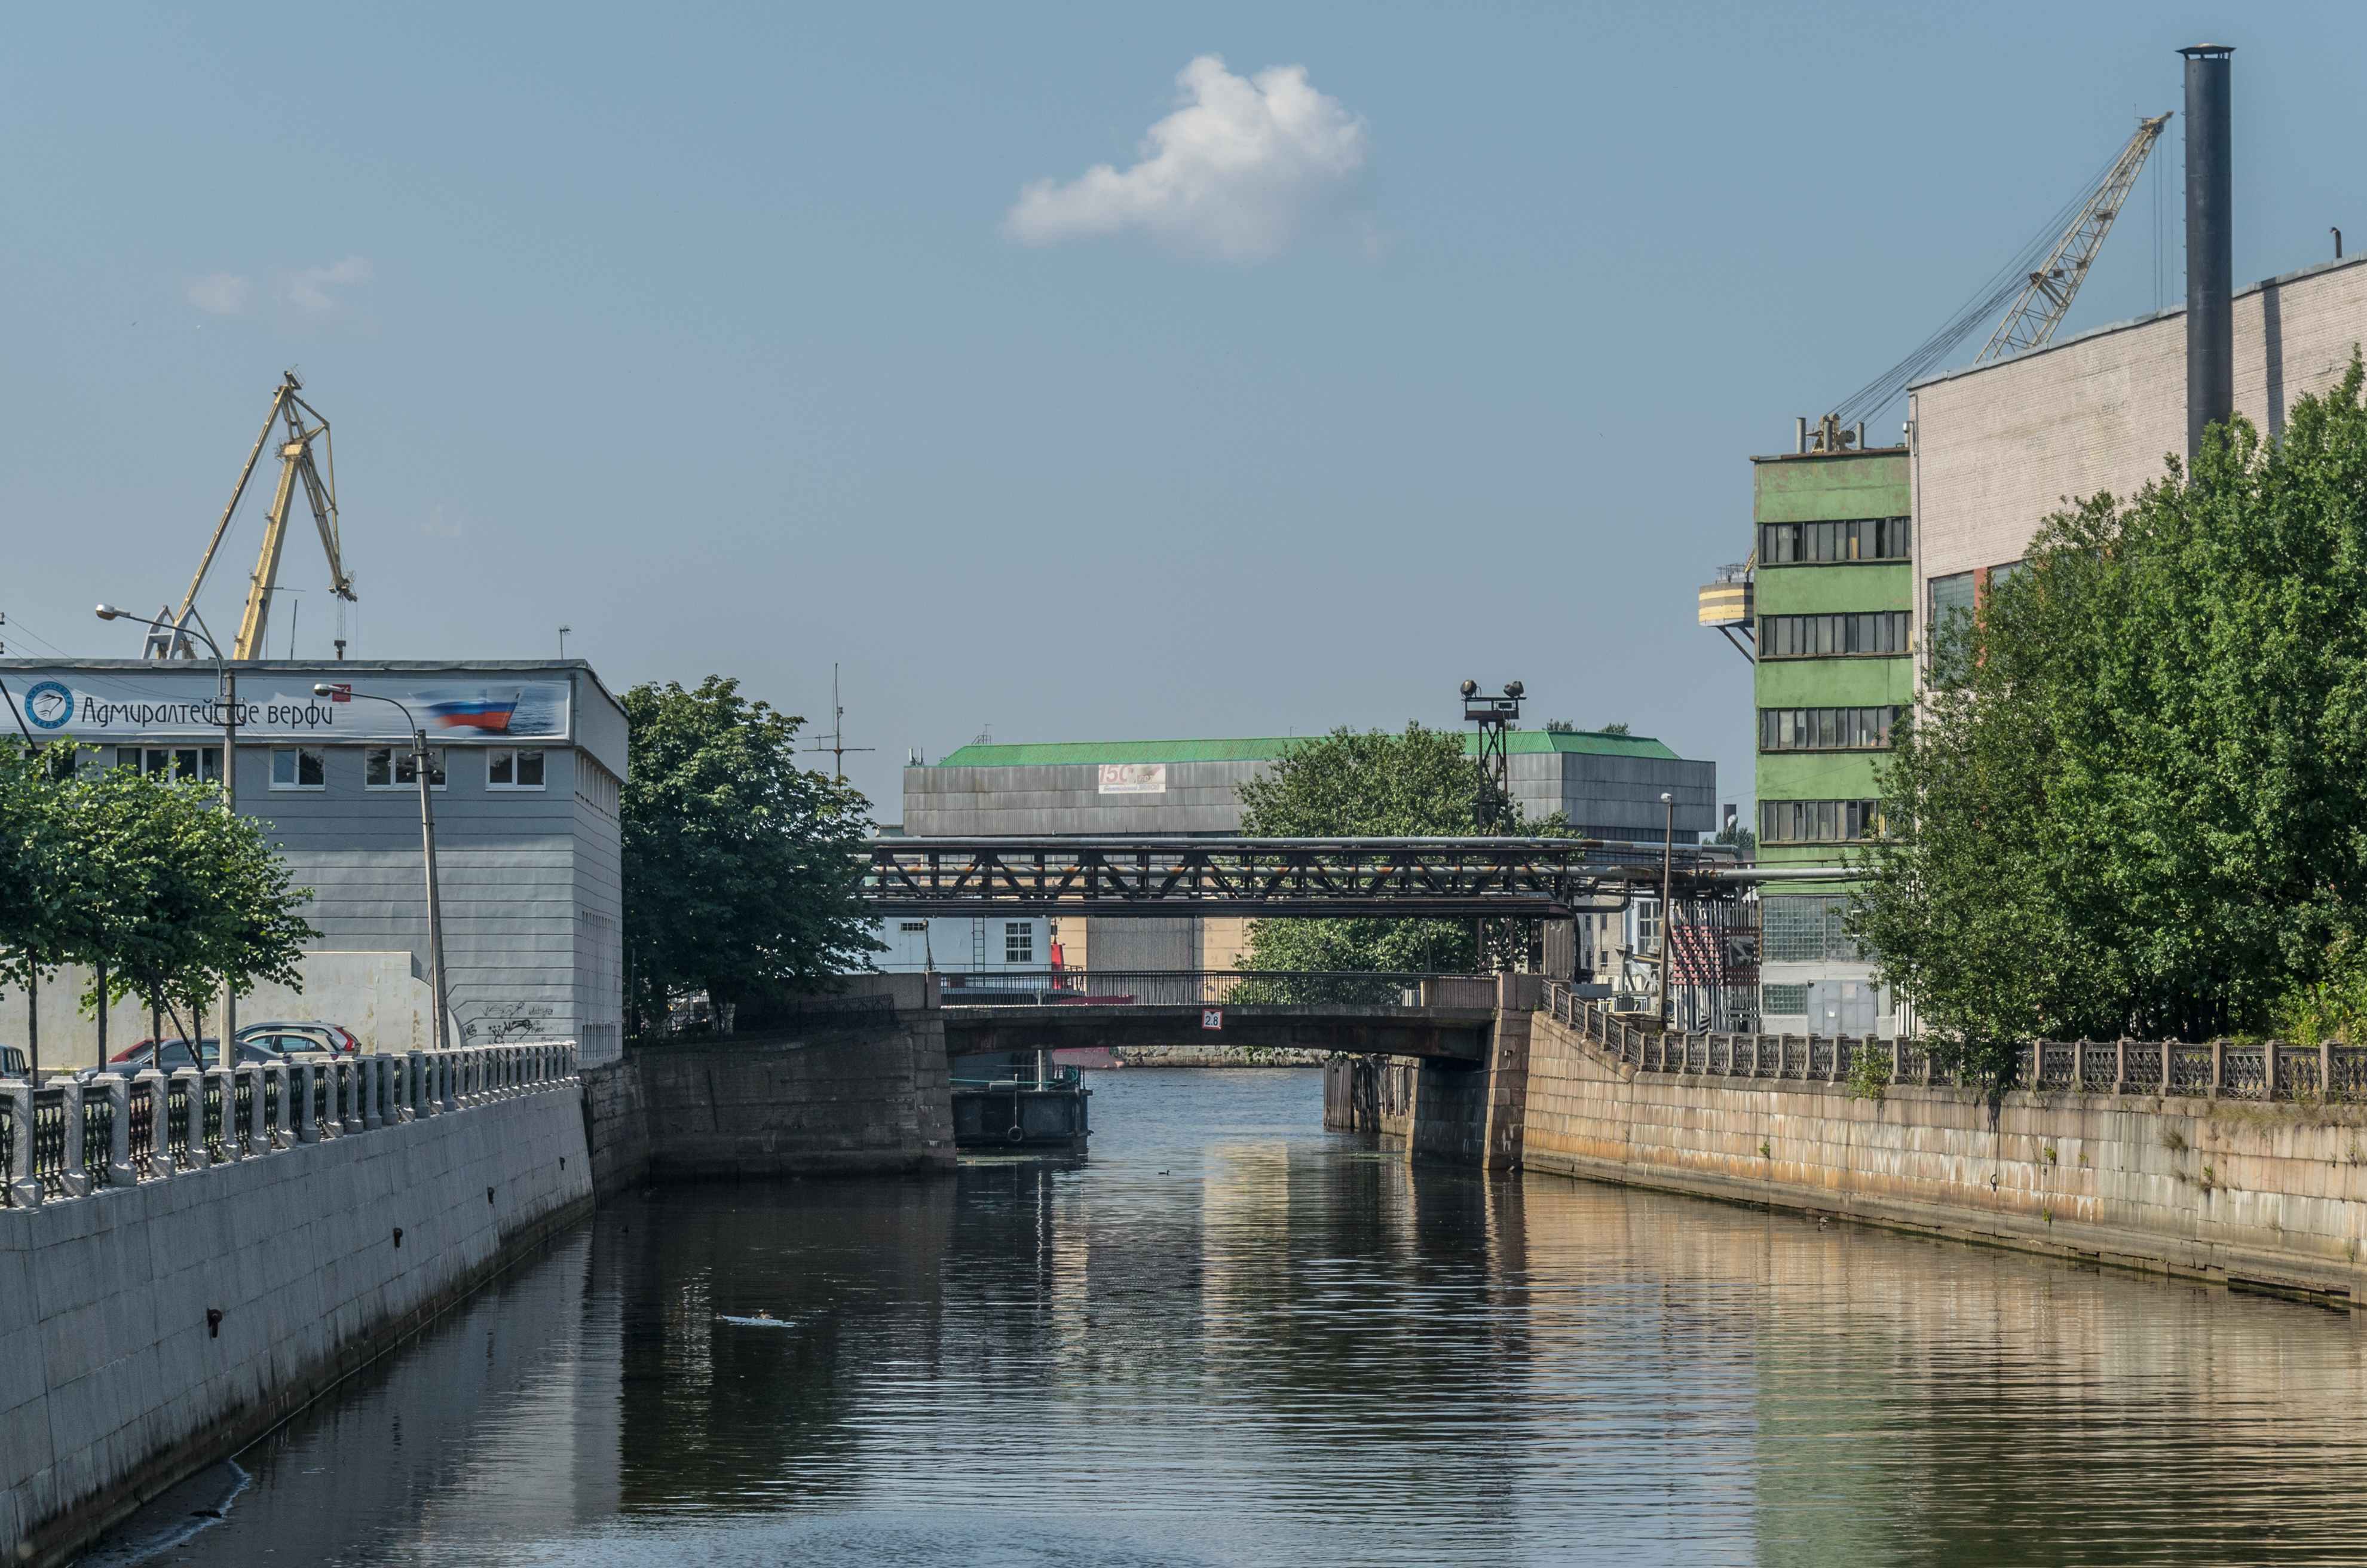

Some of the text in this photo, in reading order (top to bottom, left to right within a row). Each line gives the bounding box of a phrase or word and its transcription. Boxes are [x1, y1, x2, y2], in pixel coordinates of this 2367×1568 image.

[82, 697, 332, 729] Адмиралтейсие верфи
[33, 718, 65, 727] ВЕРФИ
[1099, 765, 1132, 783] 150
[1205, 1016, 1218, 1025] 2.8
